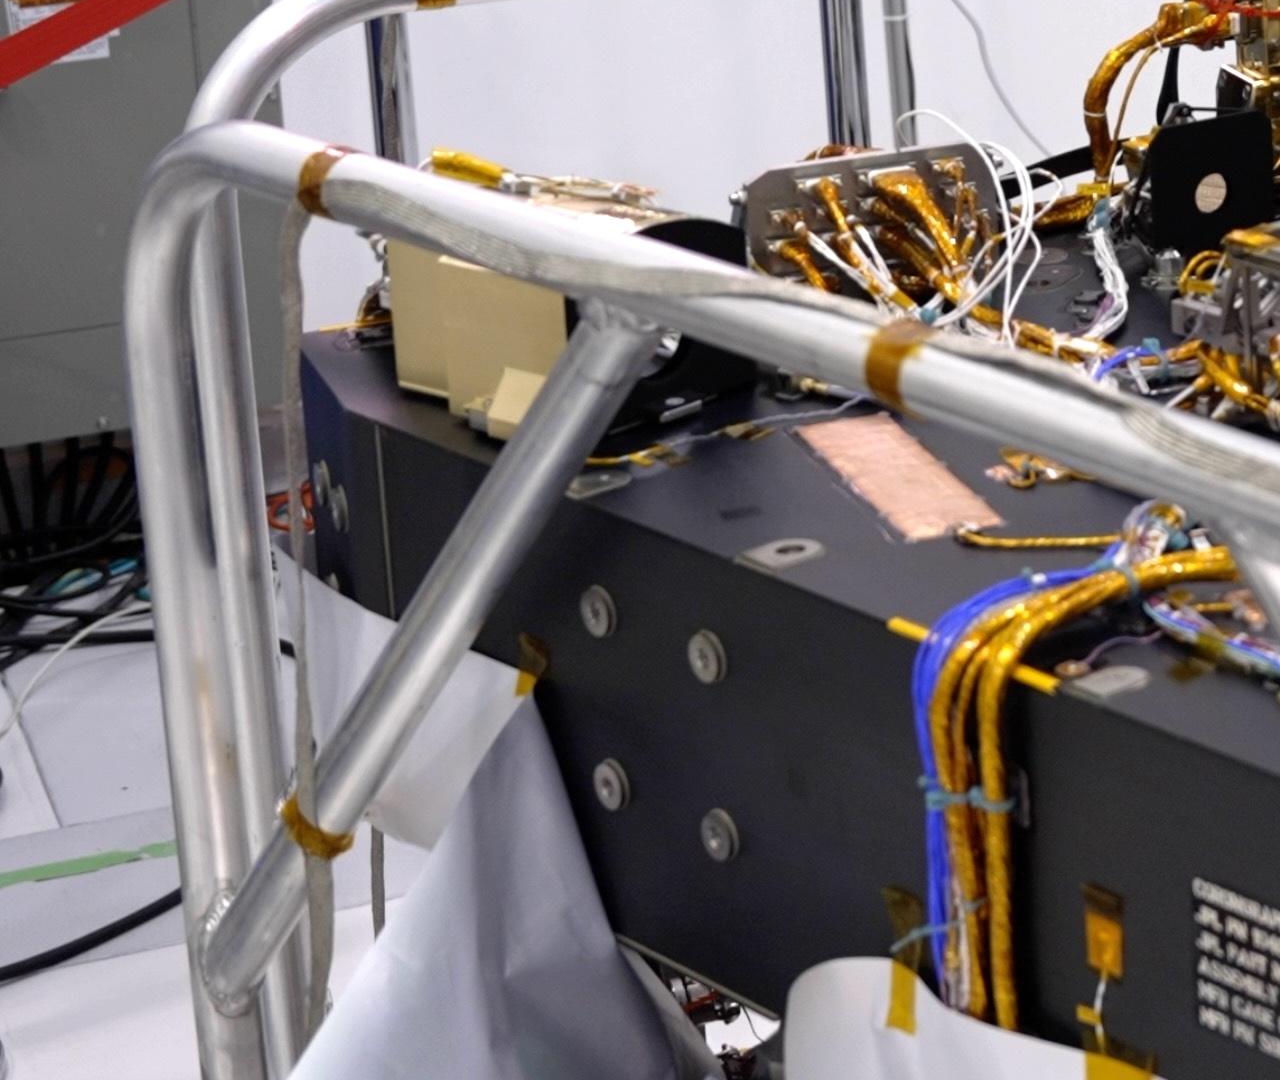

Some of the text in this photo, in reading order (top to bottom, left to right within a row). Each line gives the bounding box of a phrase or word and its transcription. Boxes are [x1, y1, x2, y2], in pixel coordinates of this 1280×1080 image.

[1194, 903, 1224, 934] JPL
[1195, 929, 1226, 959] JPL
[1225, 940, 1268, 976] PART
[1197, 954, 1280, 1006] ASSEMBLY
